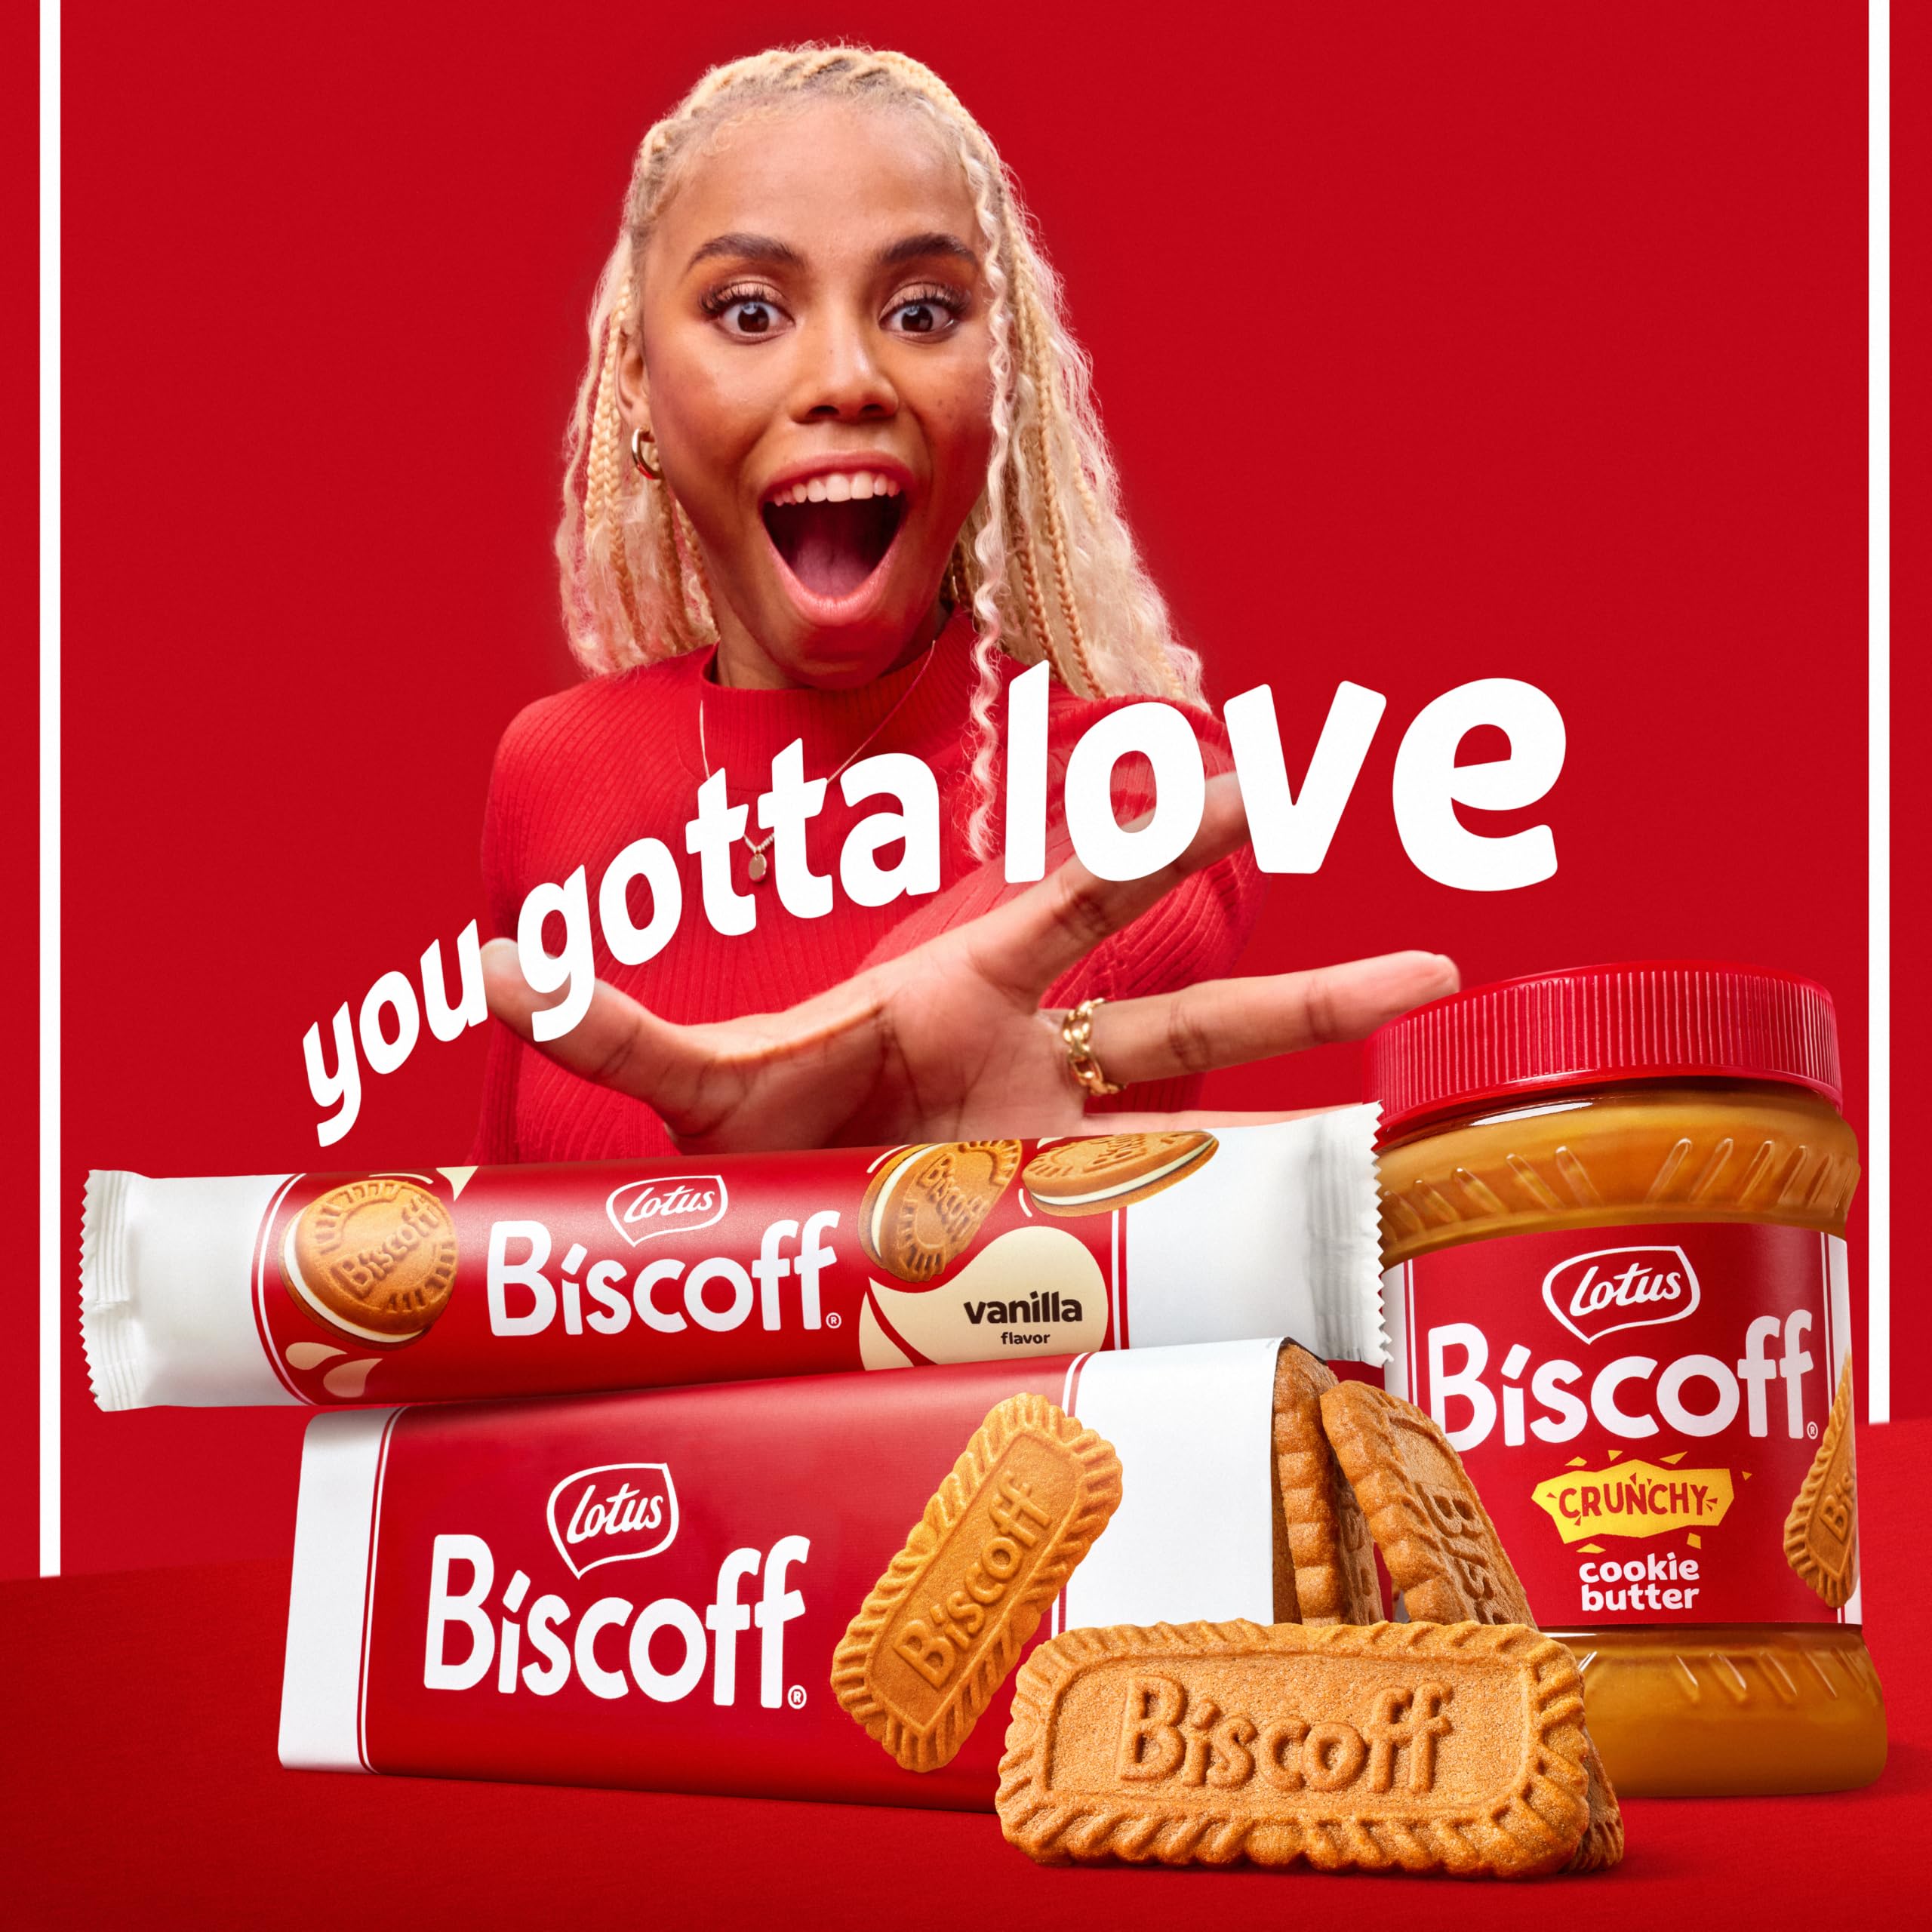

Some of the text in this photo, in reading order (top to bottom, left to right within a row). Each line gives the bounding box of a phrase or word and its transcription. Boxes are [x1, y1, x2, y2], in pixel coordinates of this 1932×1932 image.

[623, 1185, 715, 1224] Lotus
[329, 1194, 440, 1299] Biscoff
[963, 1291, 1083, 1324] vanilla
[1569, 1263, 1681, 1317] Lotus
[1000, 1331, 1051, 1345] flavor
[566, 1483, 664, 1544] Lotus
[1558, 1481, 1709, 1518] CRUNCHY
[893, 1470, 1052, 1690] Biscoff
[1579, 1552, 1700, 1583] cookie
[1581, 1583, 1700, 1611] butter
[1118, 1674, 1455, 1794] Biscoff
